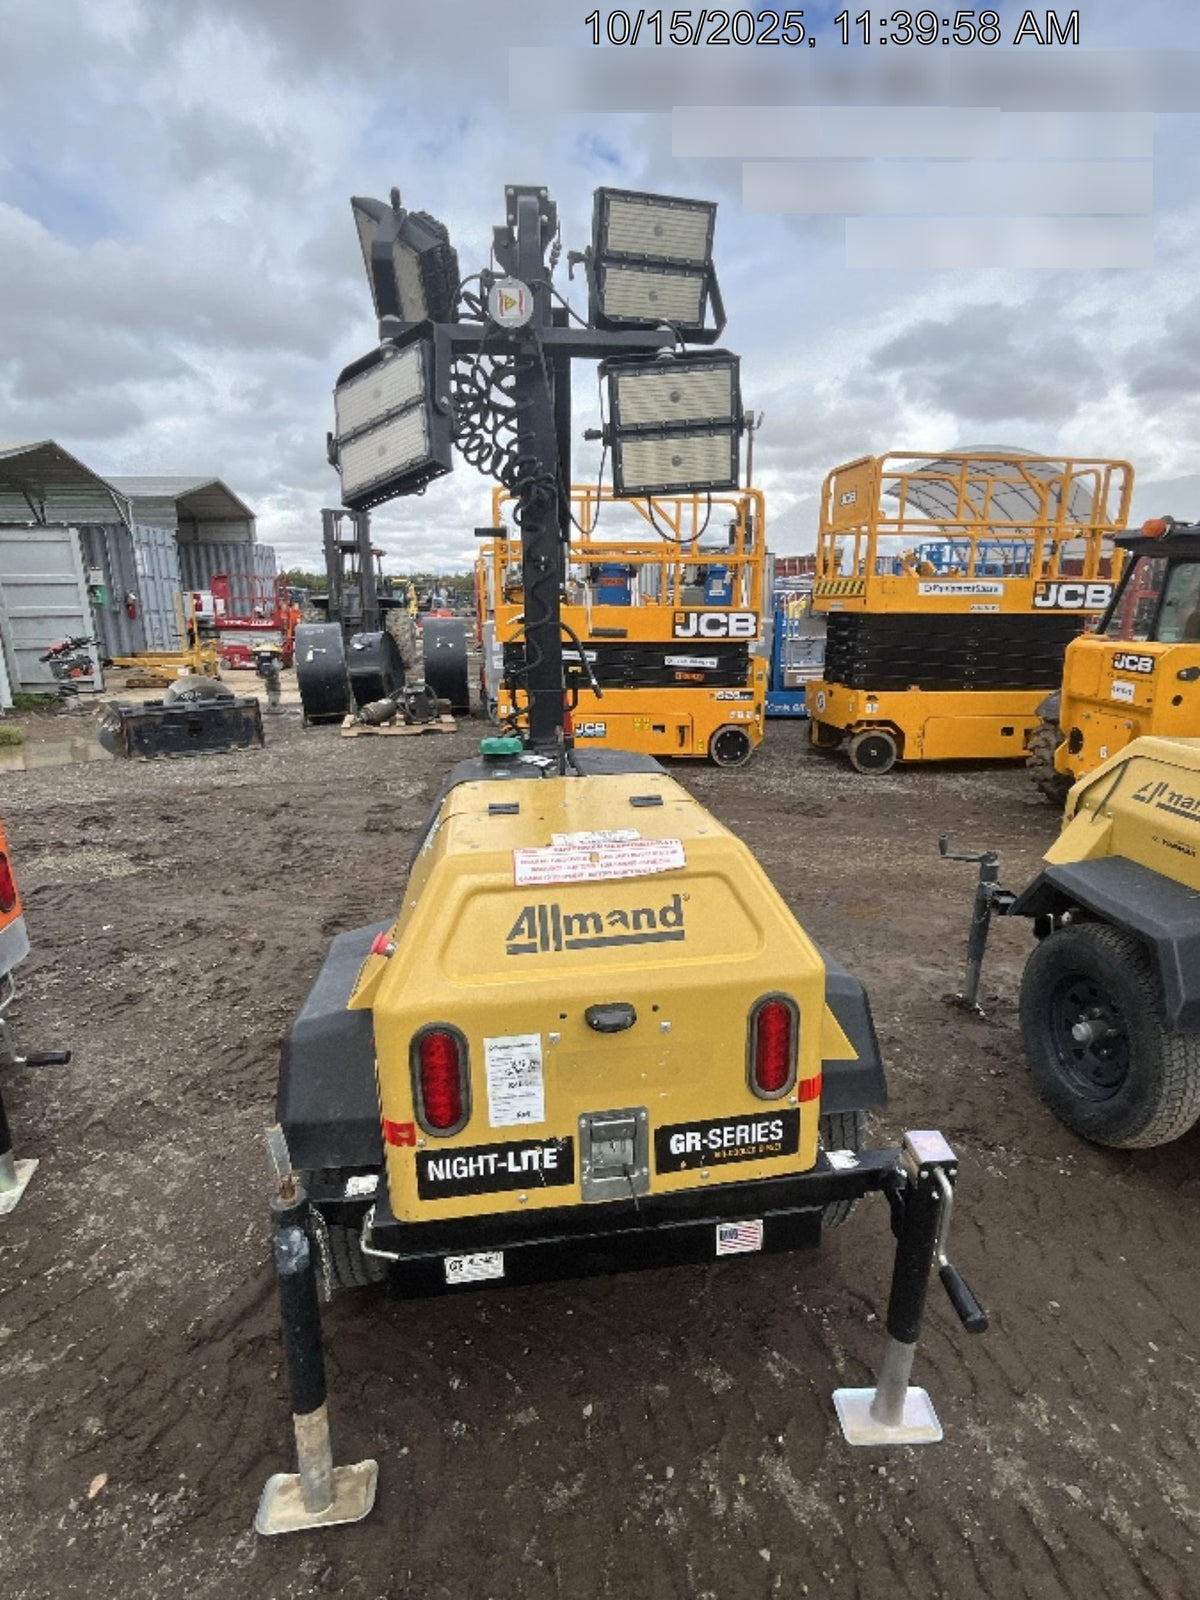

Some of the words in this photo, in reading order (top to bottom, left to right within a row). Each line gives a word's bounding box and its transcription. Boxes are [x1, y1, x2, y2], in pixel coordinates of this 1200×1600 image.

[1034, 584, 1113, 609] JCB
[674, 612, 756, 637] JCB
[1113, 654, 1153, 674] JCB
[505, 893, 686, 953] Allmand
[669, 1120, 784, 1155] GR-SERIES
[427, 1148, 558, 1182] NIGHT-LITE
